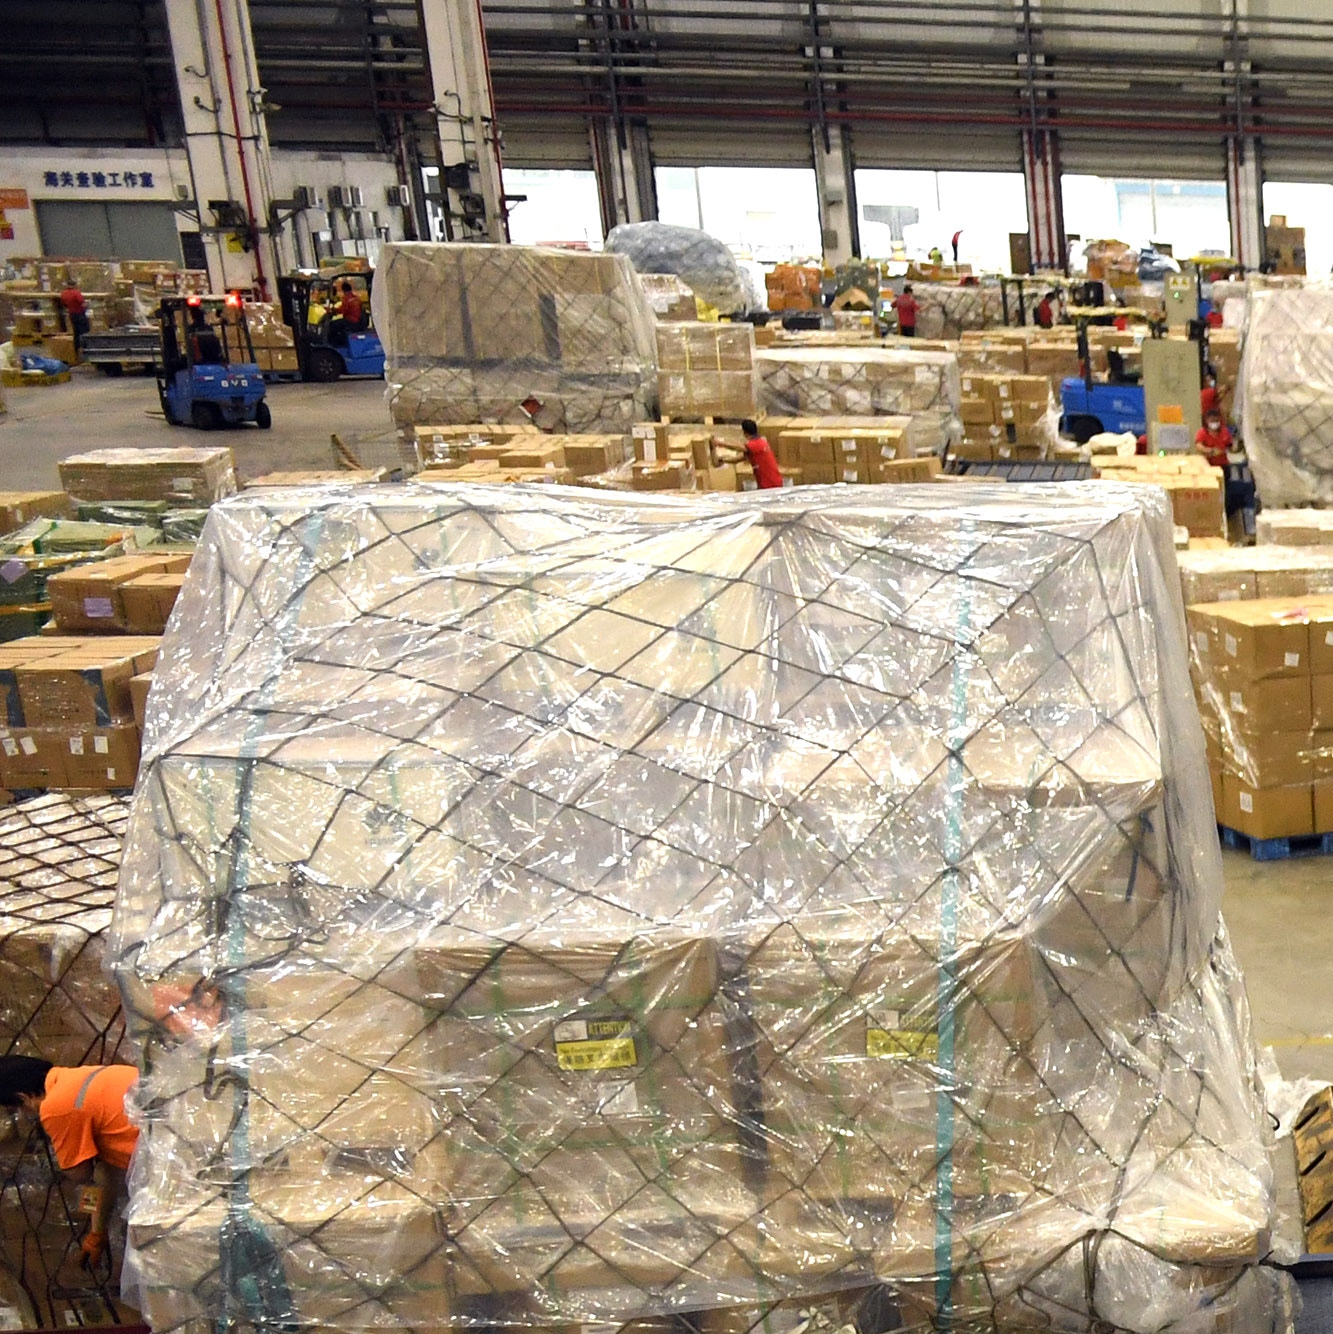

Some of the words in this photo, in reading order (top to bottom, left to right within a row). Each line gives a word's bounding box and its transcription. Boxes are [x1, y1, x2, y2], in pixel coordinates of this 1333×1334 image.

[43, 171, 155, 188] 海关查验工作室
